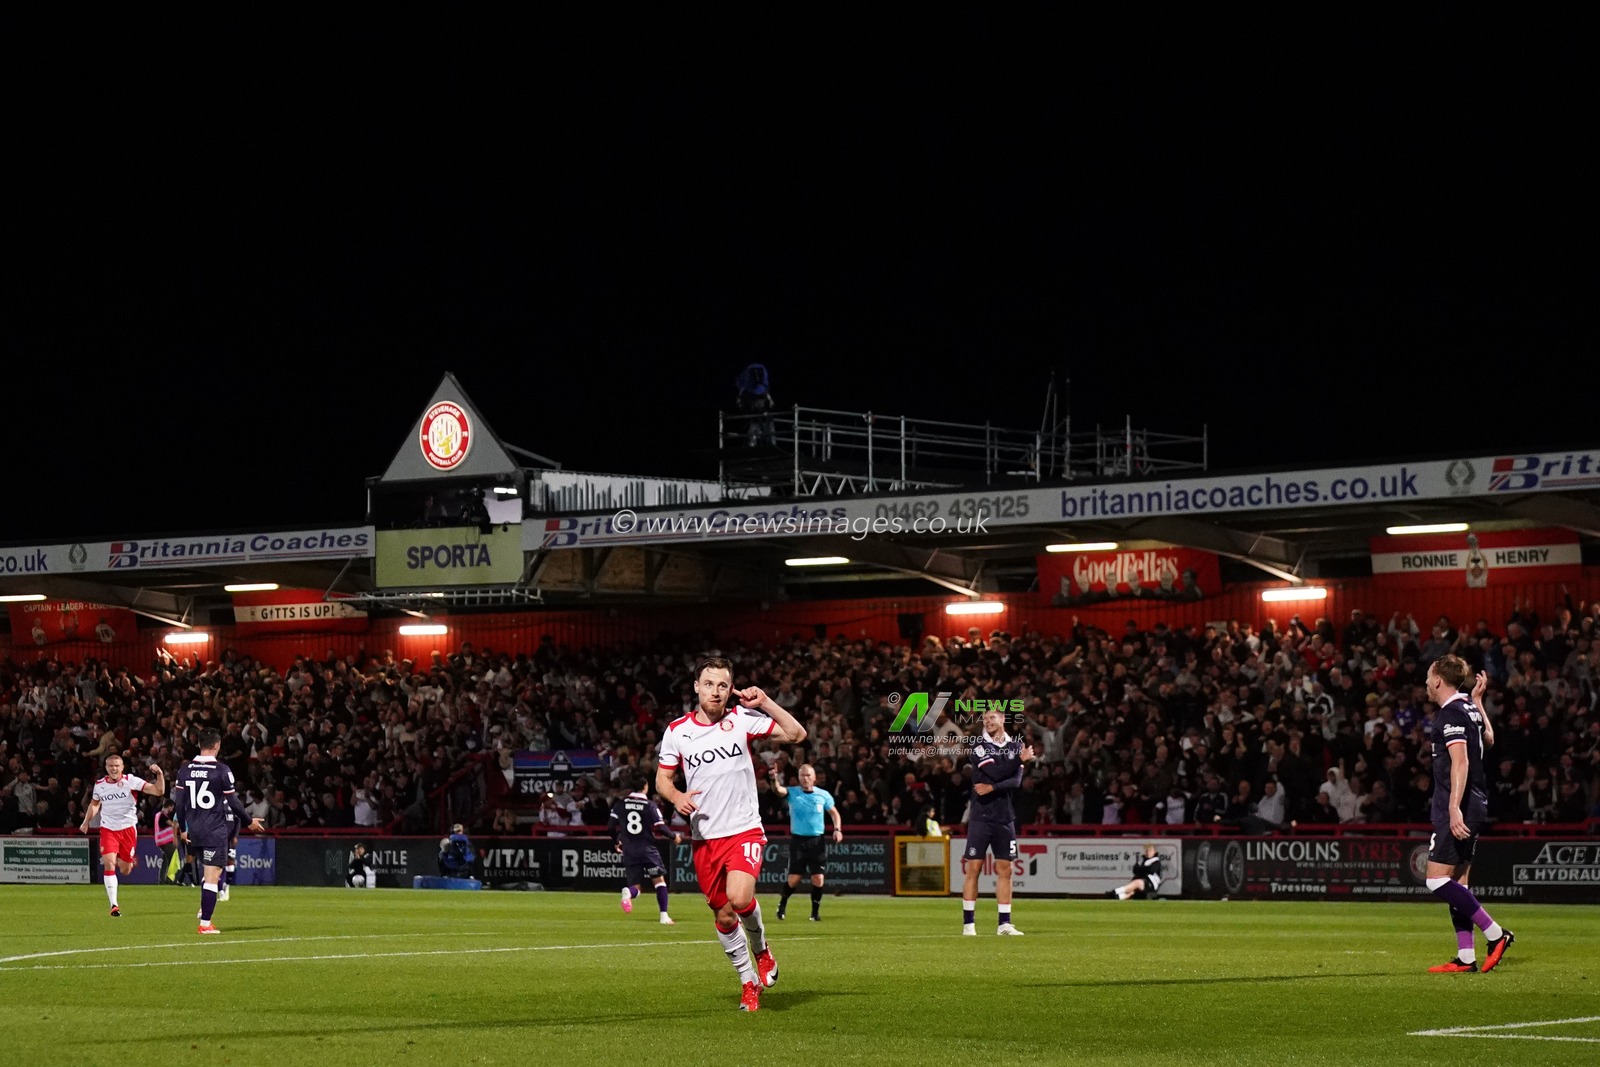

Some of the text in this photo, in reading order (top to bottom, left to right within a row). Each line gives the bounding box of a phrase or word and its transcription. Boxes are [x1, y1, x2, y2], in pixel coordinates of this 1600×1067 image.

[1488, 455, 1600, 491] Brit
[1061, 468, 1418, 518] britanniacoaches.co.uk
[875, 495, 1030, 524] 01462 436125
[108, 531, 369, 568] Britannia Coaches
[407, 543, 491, 569] SPORTA
[1402, 548, 1550, 568] RONNIE HENRY
[24, 604, 52, 613] CAPTAIN
[57, 603, 84, 611] LEADER
[299, 606, 310, 618] IS
[314, 605, 335, 617] UP!
[190, 770, 208, 778] GORE
[185, 780, 216, 810] 16
[625, 803, 645, 811] WALSH
[627, 811, 643, 835] 8
[741, 842, 761, 863] 10
[1009, 840, 1017, 854] 5
[1246, 841, 1402, 861] LINCOLNS TYRES
[1533, 842, 1587, 865] ACE
[240, 854, 273, 869] Show
[480, 848, 540, 868] VITAL
[852, 862, 884, 874] 147476
[484, 869, 540, 877] ELECTRONICS
[1518, 868, 1530, 880] &
[1270, 882, 1327, 893] Firestone
[1488, 886, 1505, 897] 722
[1506, 886, 1524, 896] 671
